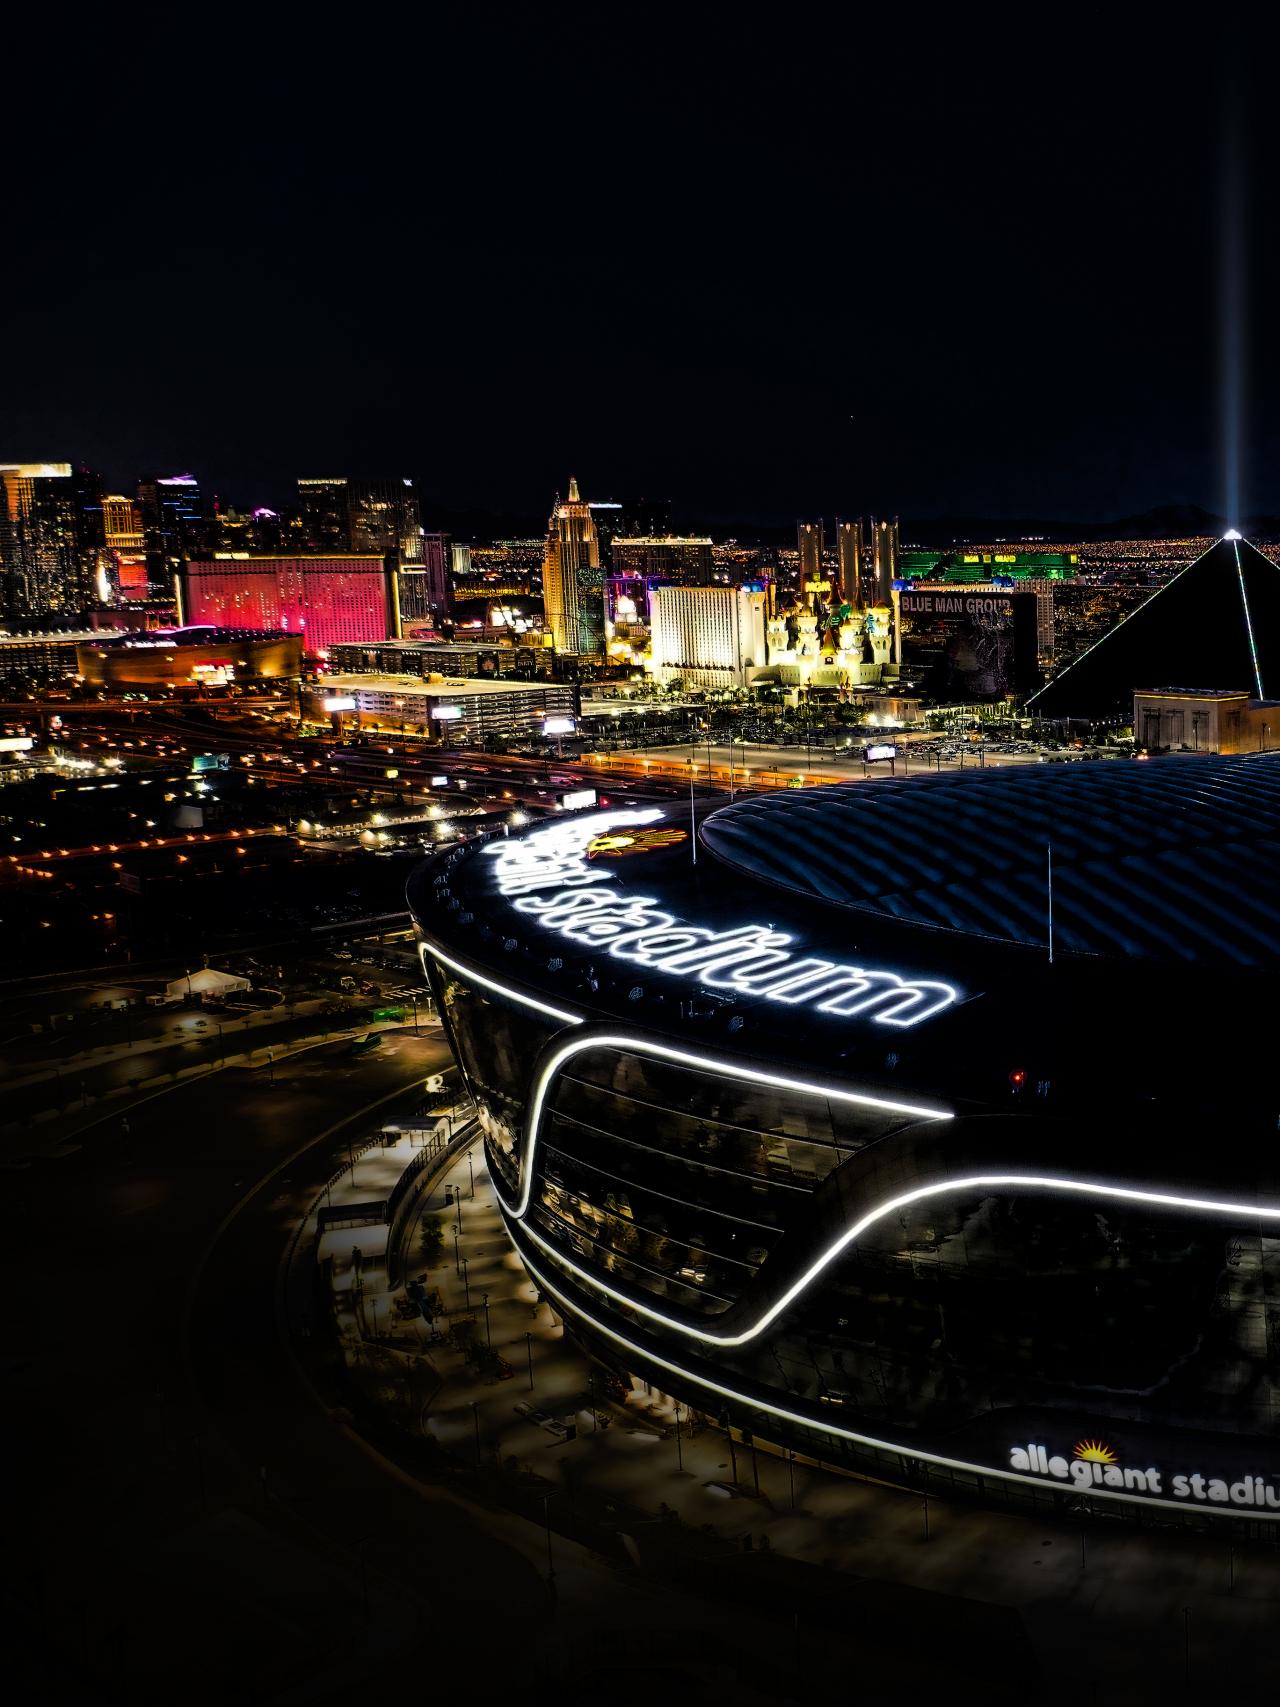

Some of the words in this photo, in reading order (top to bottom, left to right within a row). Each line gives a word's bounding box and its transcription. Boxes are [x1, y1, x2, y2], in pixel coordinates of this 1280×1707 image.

[902, 596, 932, 612] BLUE
[935, 597, 962, 613] MAN
[966, 598, 1011, 614] GROUP
[512, 887, 958, 1026] stadium
[1009, 1443, 1162, 1490] allegiant
